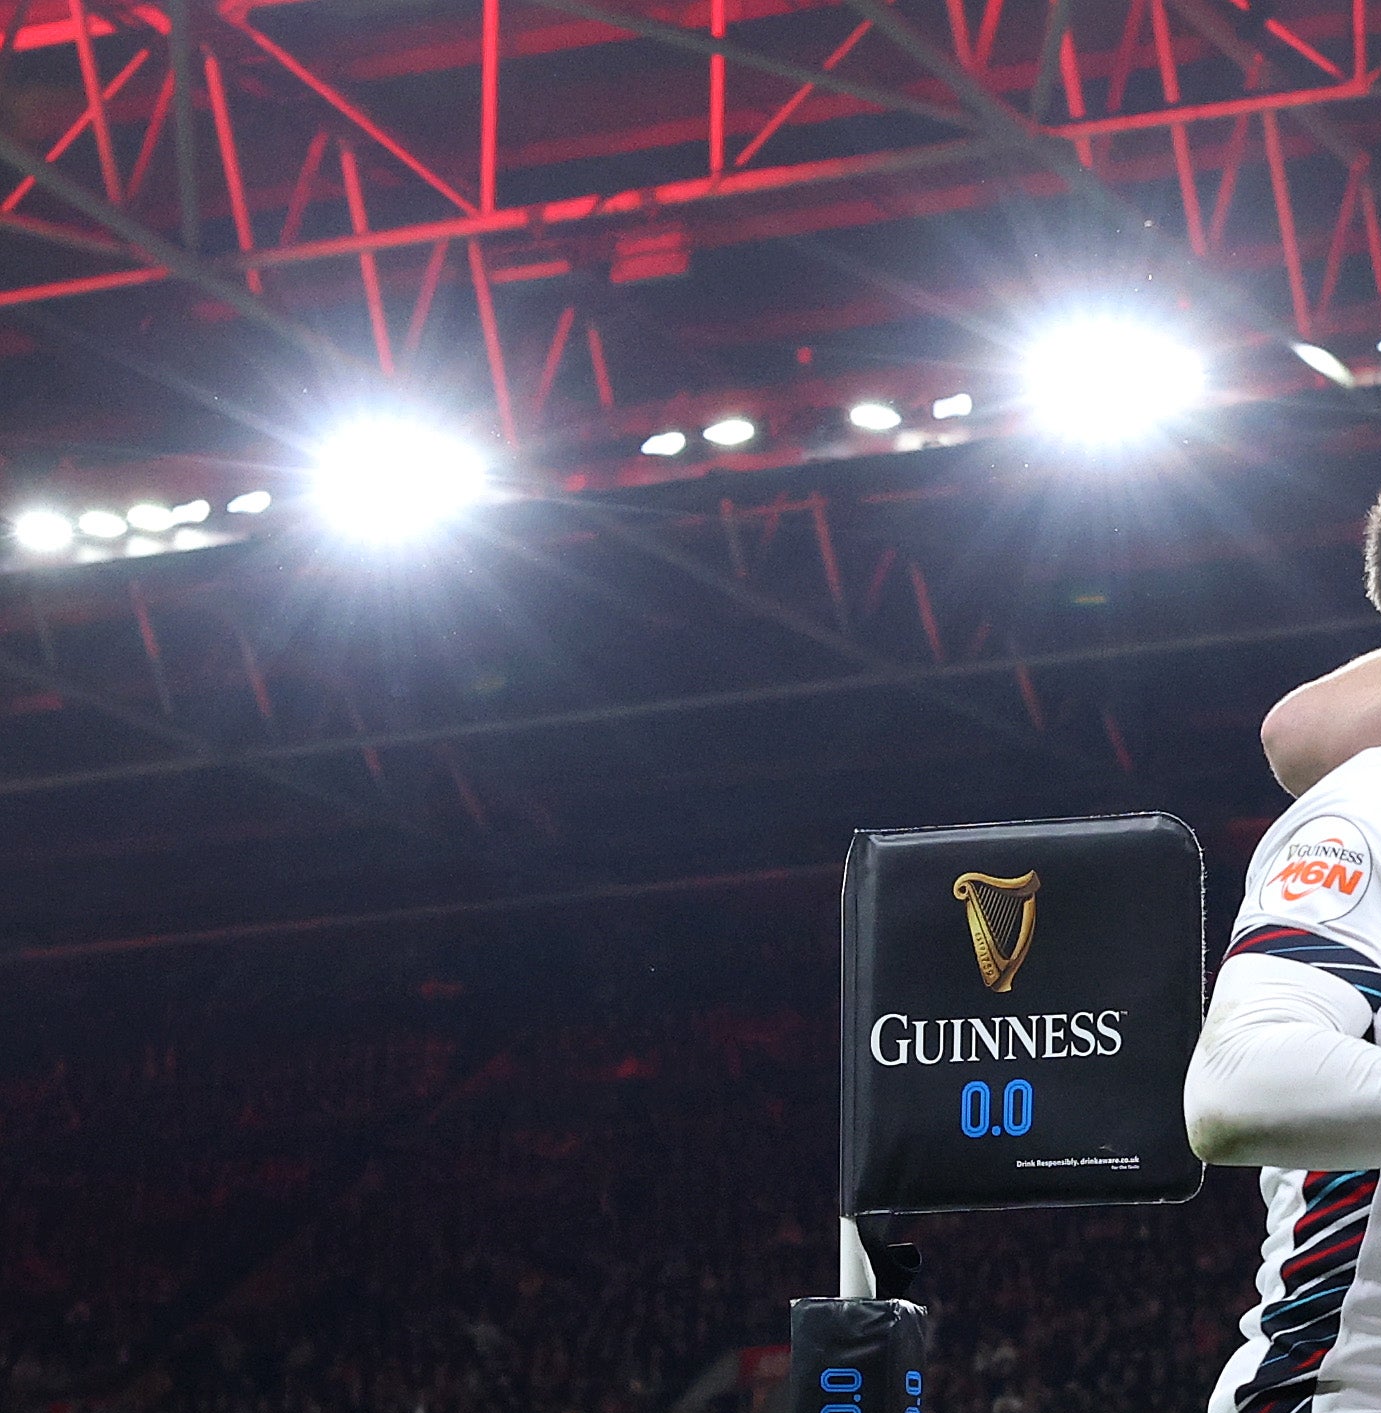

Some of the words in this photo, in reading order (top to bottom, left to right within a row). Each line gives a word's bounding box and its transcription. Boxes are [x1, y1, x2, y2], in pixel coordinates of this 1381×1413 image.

[1298, 844, 1364, 866] GUINNESS
[870, 1010, 1123, 1067] GUINNESS
[961, 1078, 1034, 1139] 0.0
[1016, 1159, 1036, 1168] Drink
